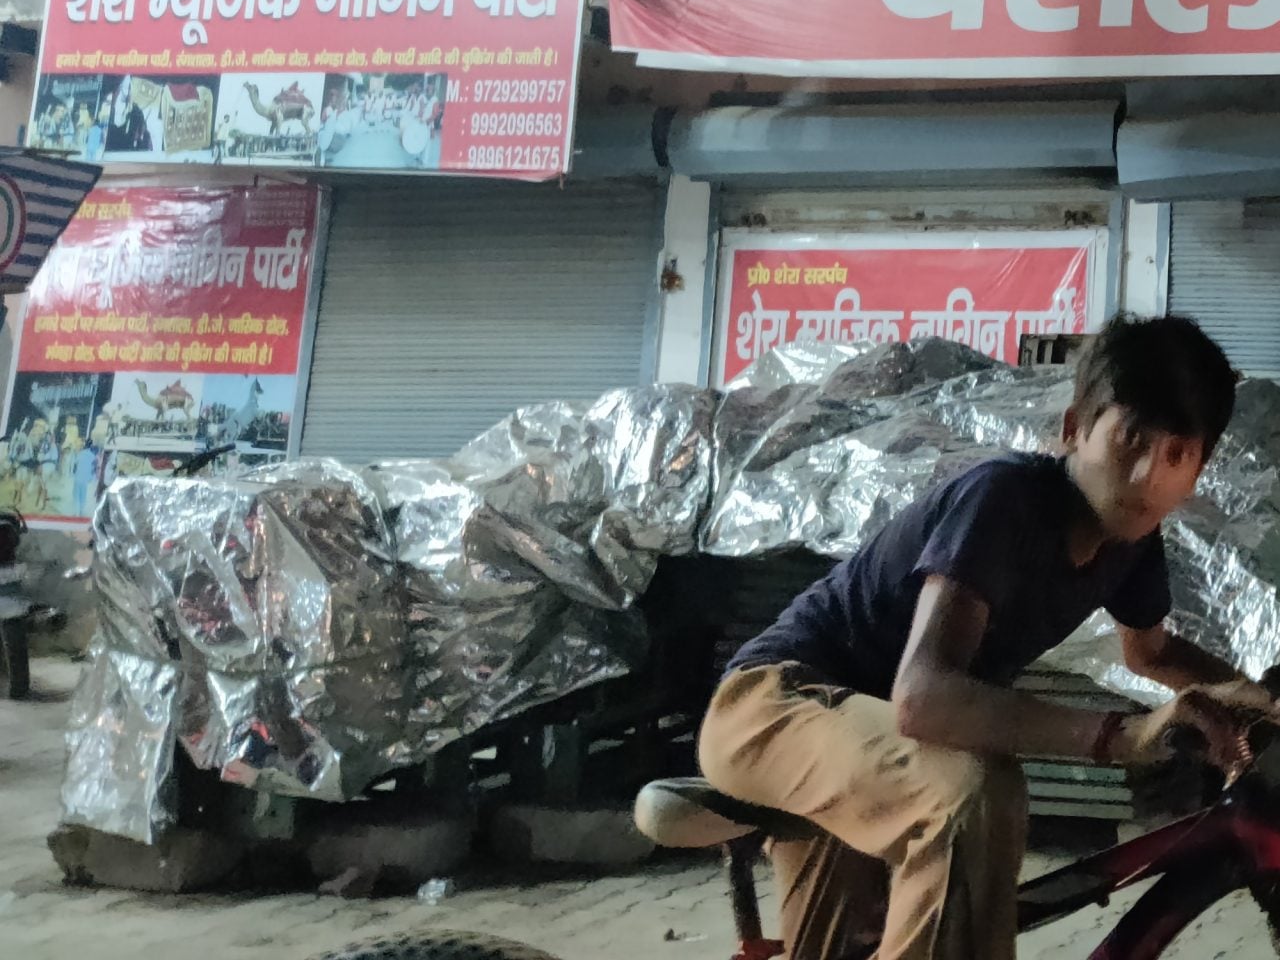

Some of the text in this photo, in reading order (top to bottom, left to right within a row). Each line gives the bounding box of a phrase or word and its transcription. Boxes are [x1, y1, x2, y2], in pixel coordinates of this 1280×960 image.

[474, 79, 566, 103] 9729299757
[470, 112, 562, 136] 9992096563
[467, 145, 560, 170] 9896121675
[253, 227, 306, 290] पार्टी
[774, 261, 801, 285] शेरा
[804, 261, 848, 285] सरपंच
